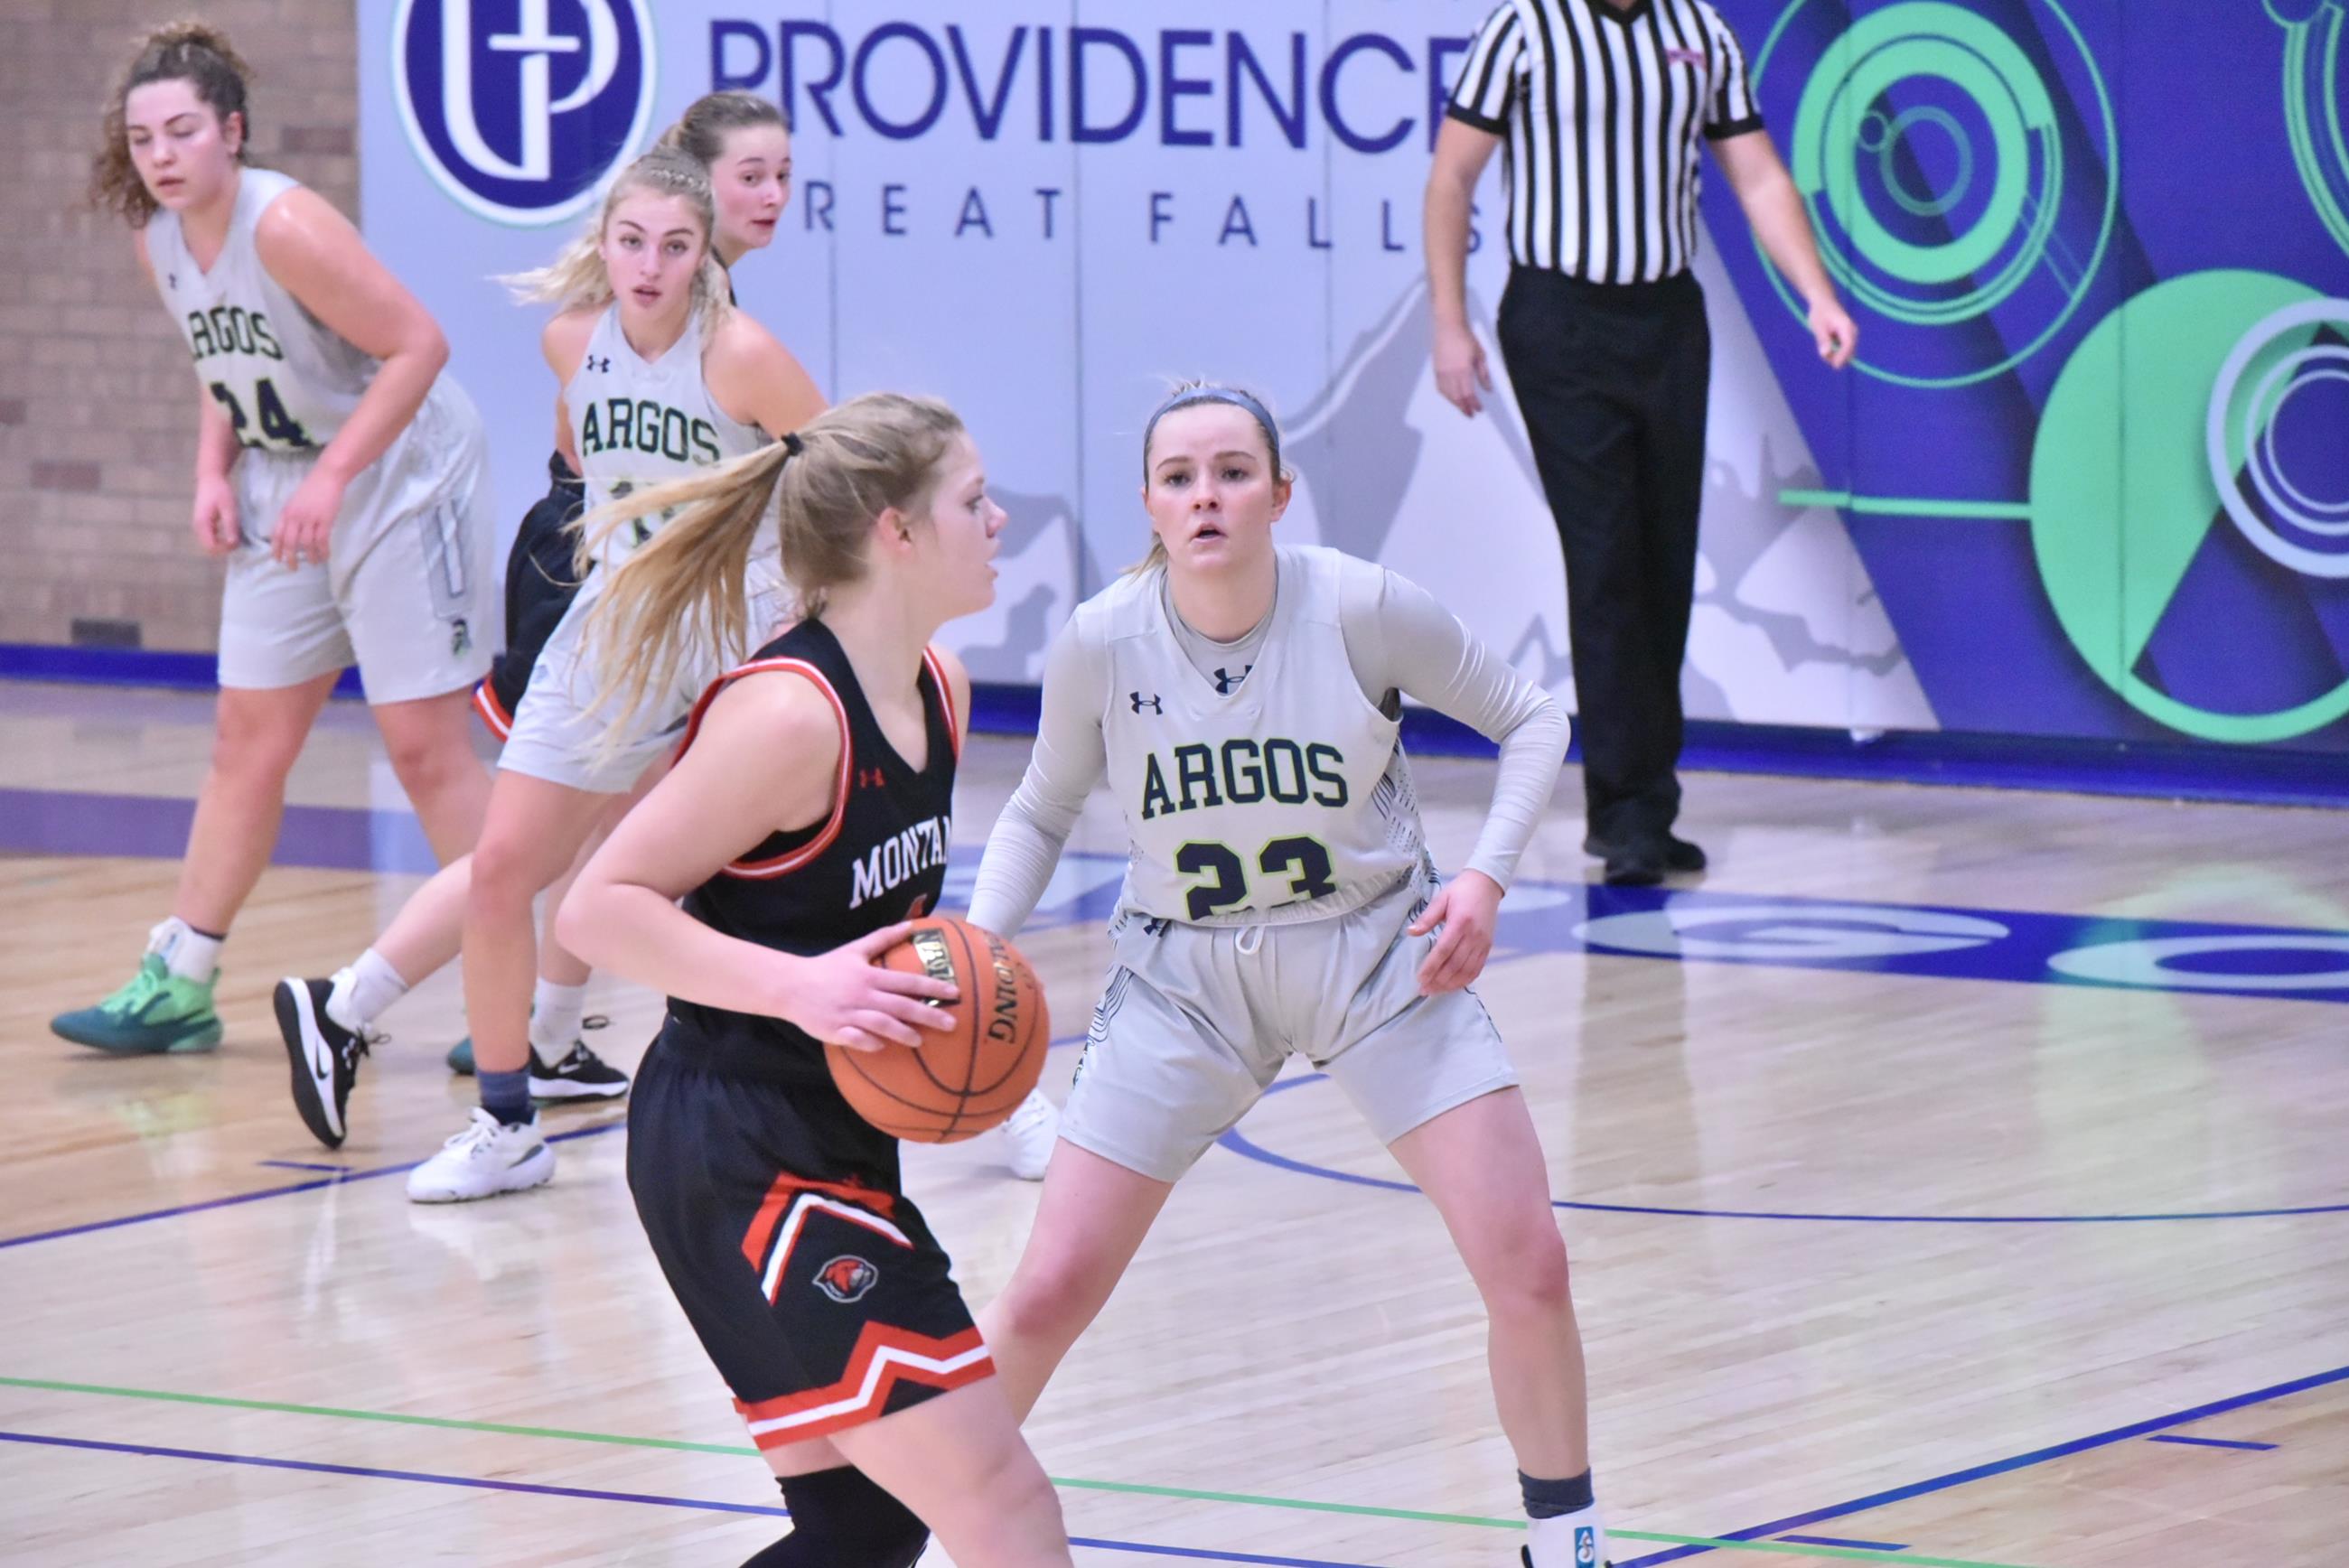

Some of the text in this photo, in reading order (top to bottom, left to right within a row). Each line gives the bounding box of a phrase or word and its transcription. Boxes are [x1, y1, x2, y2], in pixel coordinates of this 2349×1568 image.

[804, 181, 1062, 240] REAT
[583, 397, 721, 468] ARGOS
[1141, 738, 1349, 820] ARGOS
[1174, 833, 1337, 921] 23
